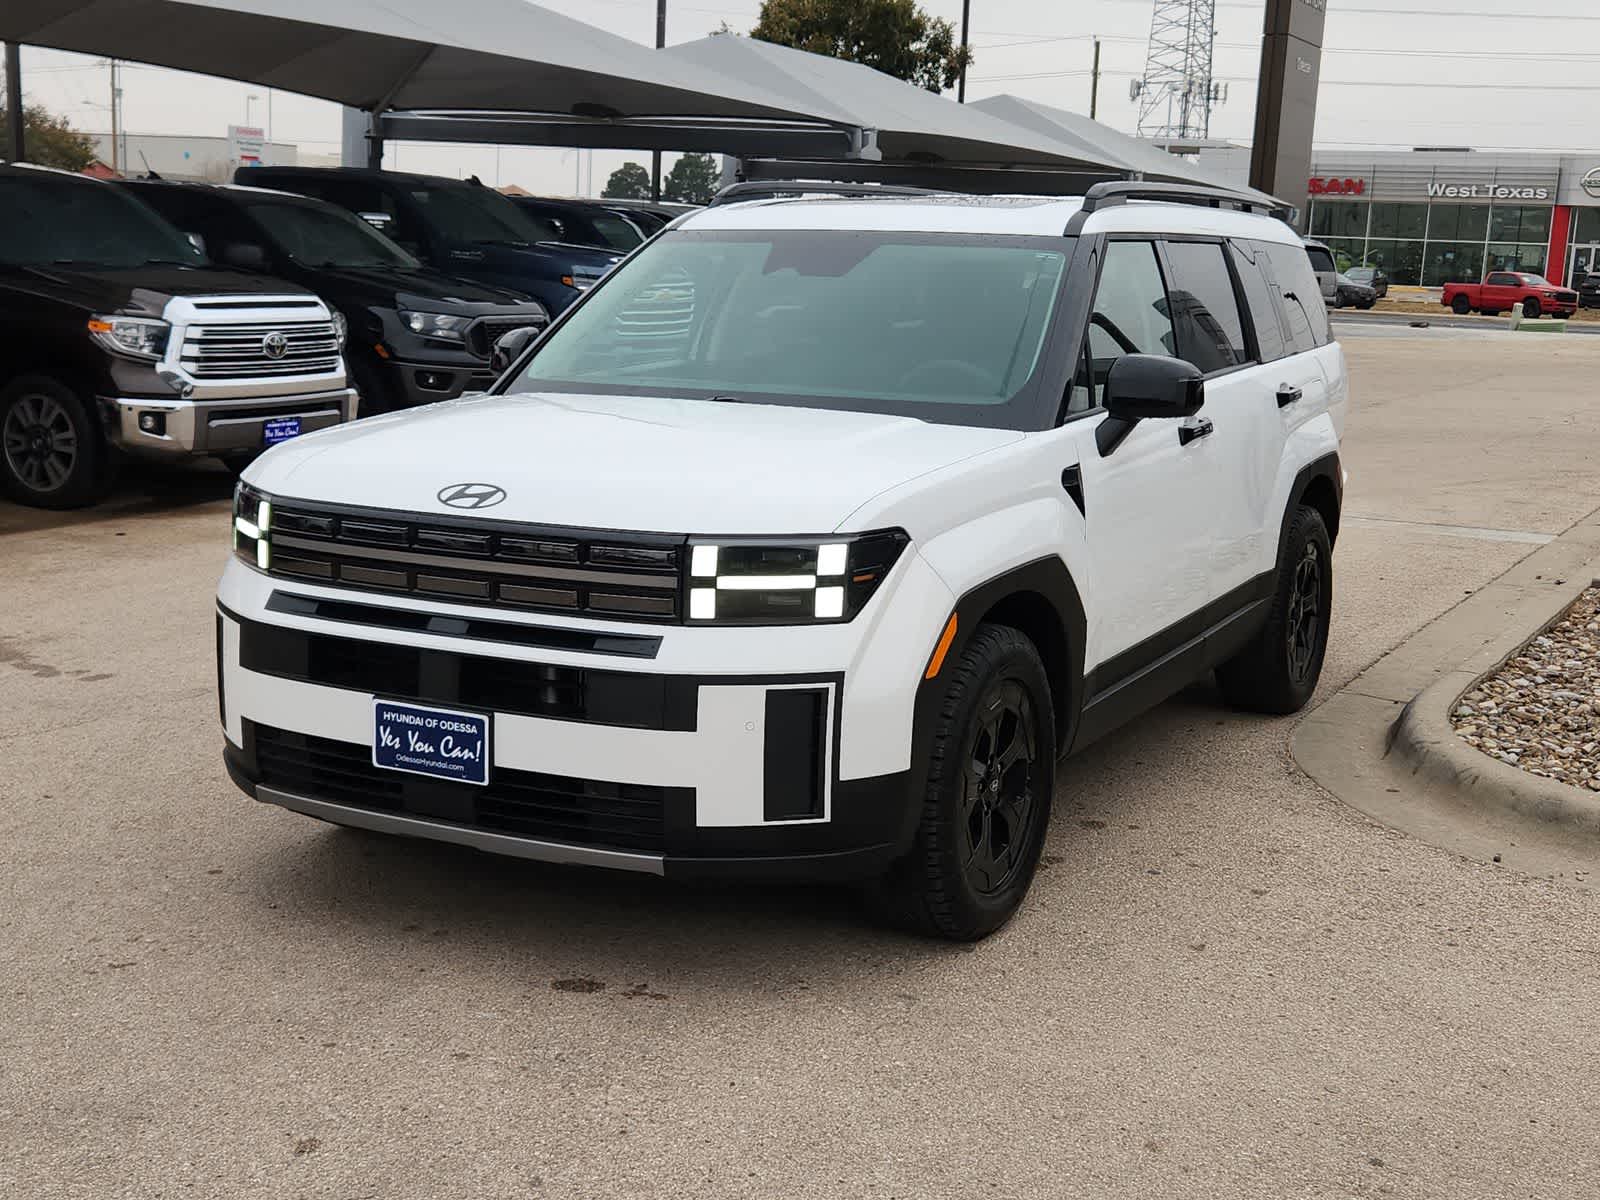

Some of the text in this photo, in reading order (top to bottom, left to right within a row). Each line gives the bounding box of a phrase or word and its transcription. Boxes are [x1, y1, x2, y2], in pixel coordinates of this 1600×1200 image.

[1427, 183, 1548, 200] West Texas
[383, 711, 478, 735] HYUNDAI OF ODESSA
[379, 725, 481, 762] Yes You Can!
[395, 753, 465, 772] OdessaHyundai.com
